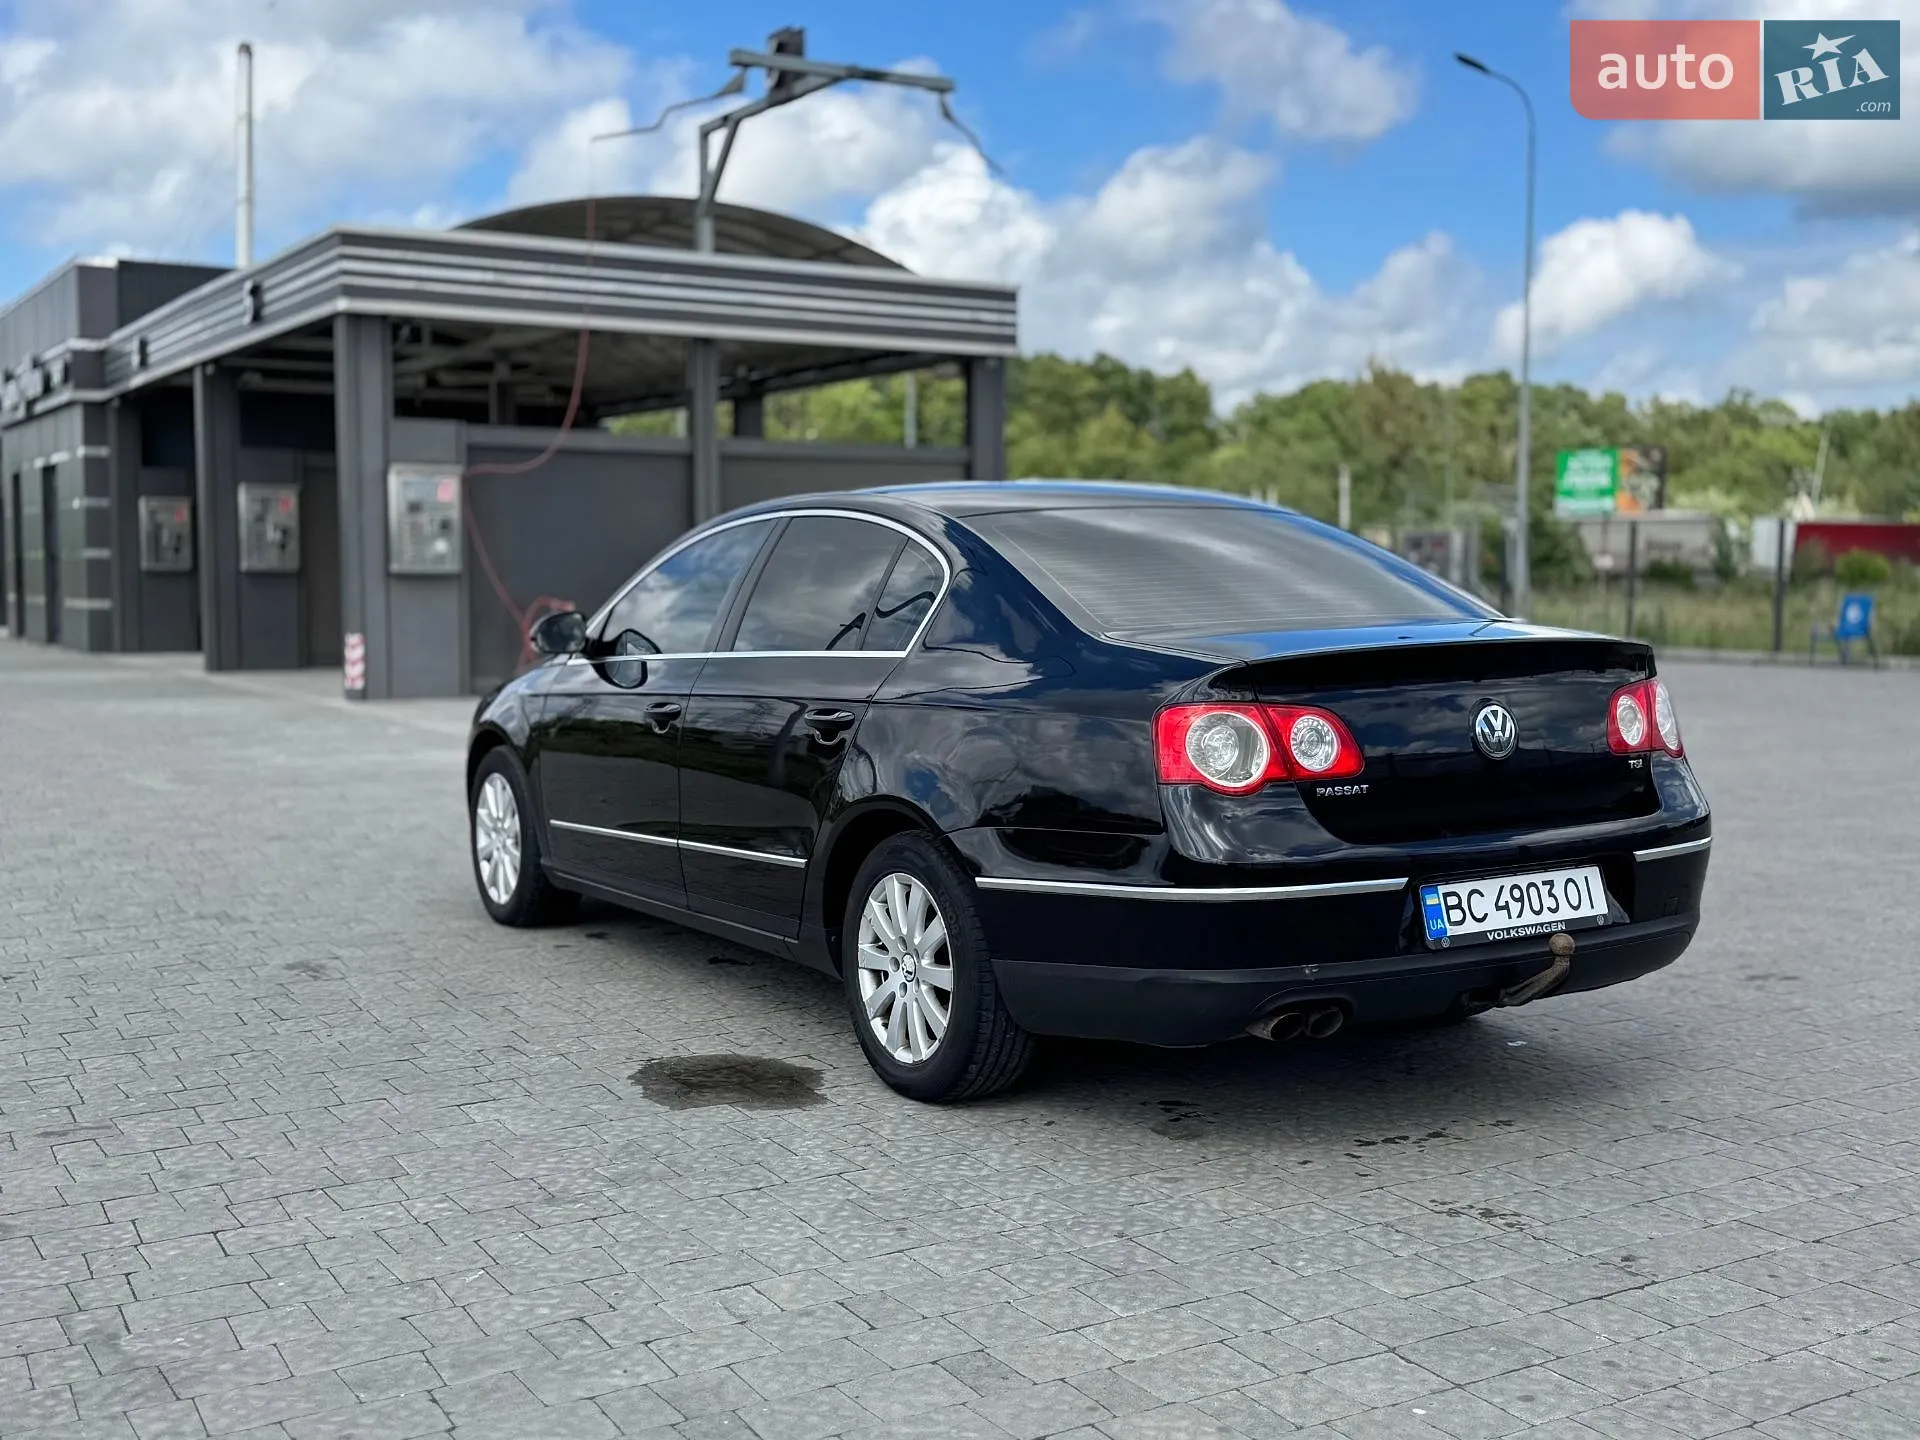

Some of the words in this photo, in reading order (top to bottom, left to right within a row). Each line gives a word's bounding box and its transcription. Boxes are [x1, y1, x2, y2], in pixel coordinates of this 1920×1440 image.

[1316, 784, 1369, 797] PASSAT
[1442, 888, 1488, 926] BC
[1494, 879, 1560, 920] 4903
[1430, 919, 1445, 931] UA
[1486, 920, 1567, 941] VOLKSWAGEN
